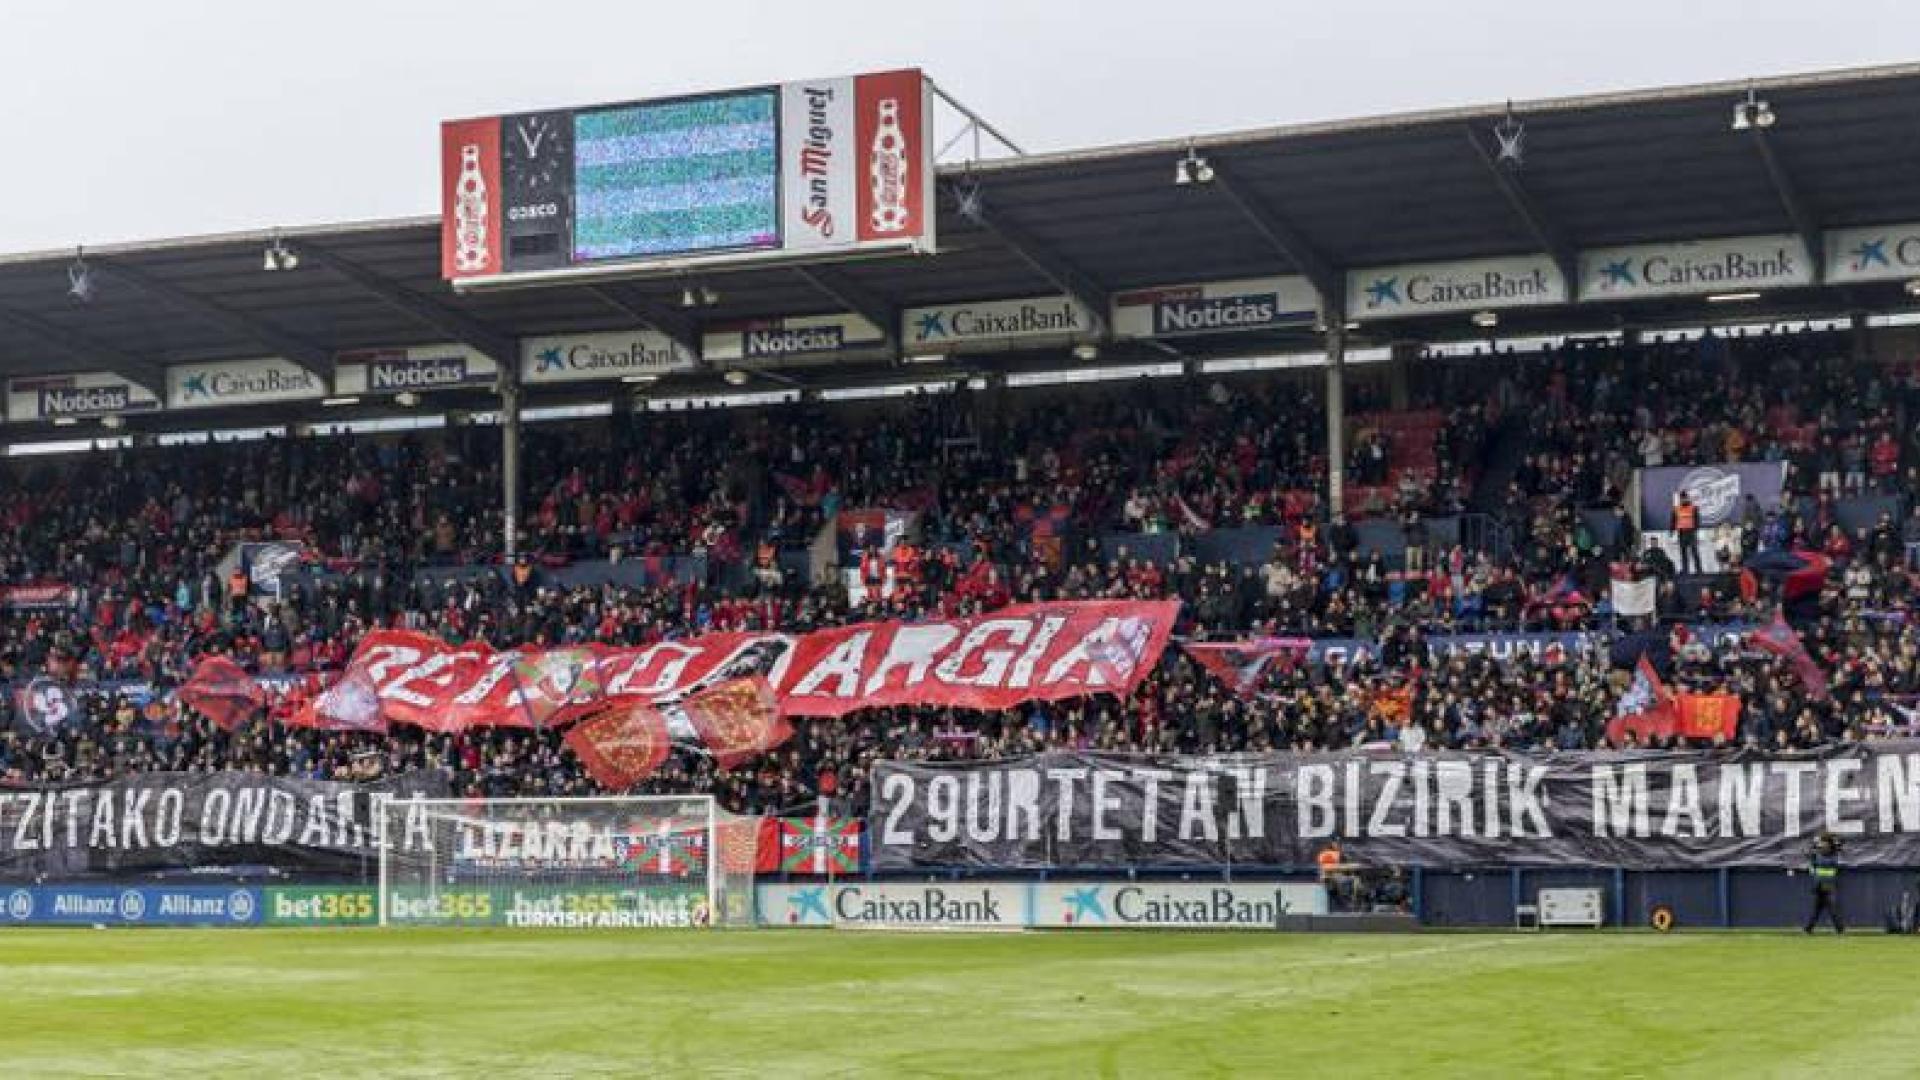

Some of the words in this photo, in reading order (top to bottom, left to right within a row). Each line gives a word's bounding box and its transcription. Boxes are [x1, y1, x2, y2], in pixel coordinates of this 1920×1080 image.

[1407, 258, 1548, 304] CaixaBank
[1644, 248, 1794, 285] CaixaBank
[952, 303, 1080, 336] CaixaBank
[1160, 297, 1273, 330] Noticias
[568, 339, 683, 370] CaixaBank
[749, 329, 841, 355] Noticias
[372, 362, 463, 388] Noticias
[44, 388, 127, 413] Noticias
[1298, 759, 1552, 838] BIZIRIK
[54, 894, 115, 915] Allianz
[159, 894, 224, 915] Allianz
[275, 892, 373, 918] bet365
[391, 892, 491, 918] bet365
[835, 887, 1001, 921] CaixaBank
[1114, 887, 1292, 923] CaixaBank
